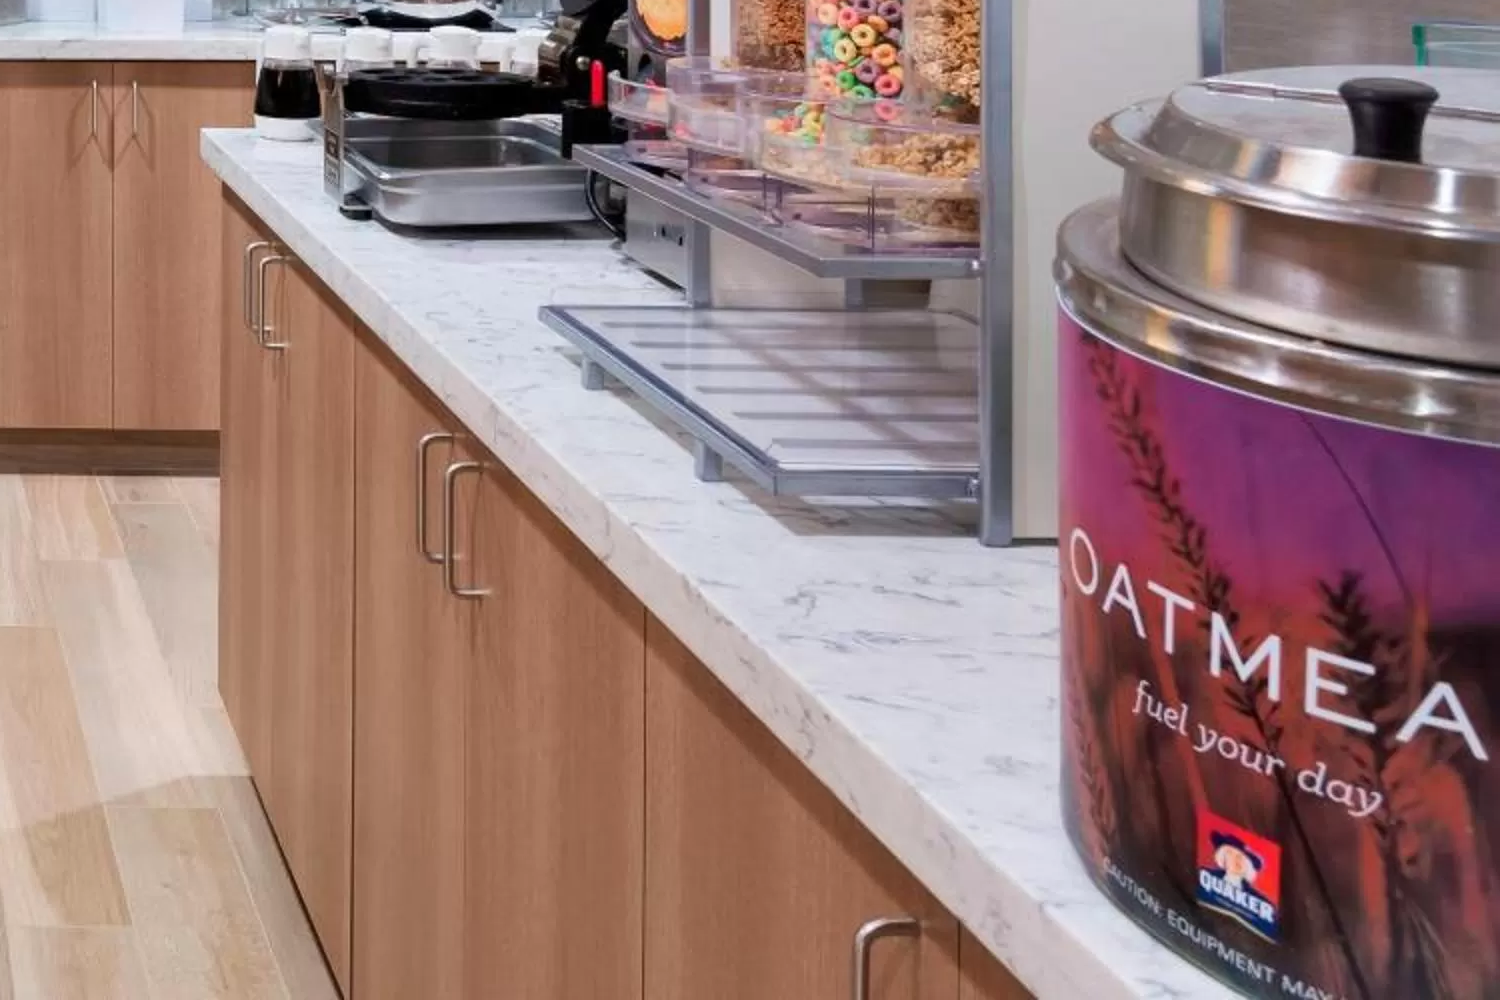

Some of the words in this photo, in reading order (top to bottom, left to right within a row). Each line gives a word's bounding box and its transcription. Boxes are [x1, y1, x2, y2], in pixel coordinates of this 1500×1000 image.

[1068, 527, 1490, 762] OATMEA
[1132, 680, 1188, 737] fuel
[1194, 724, 1286, 777] your
[1297, 761, 1384, 817] day
[1103, 855, 1164, 919] CAUTION:
[1167, 907, 1277, 985] EQUIPMENT
[1199, 869, 1275, 924] QUAKER
